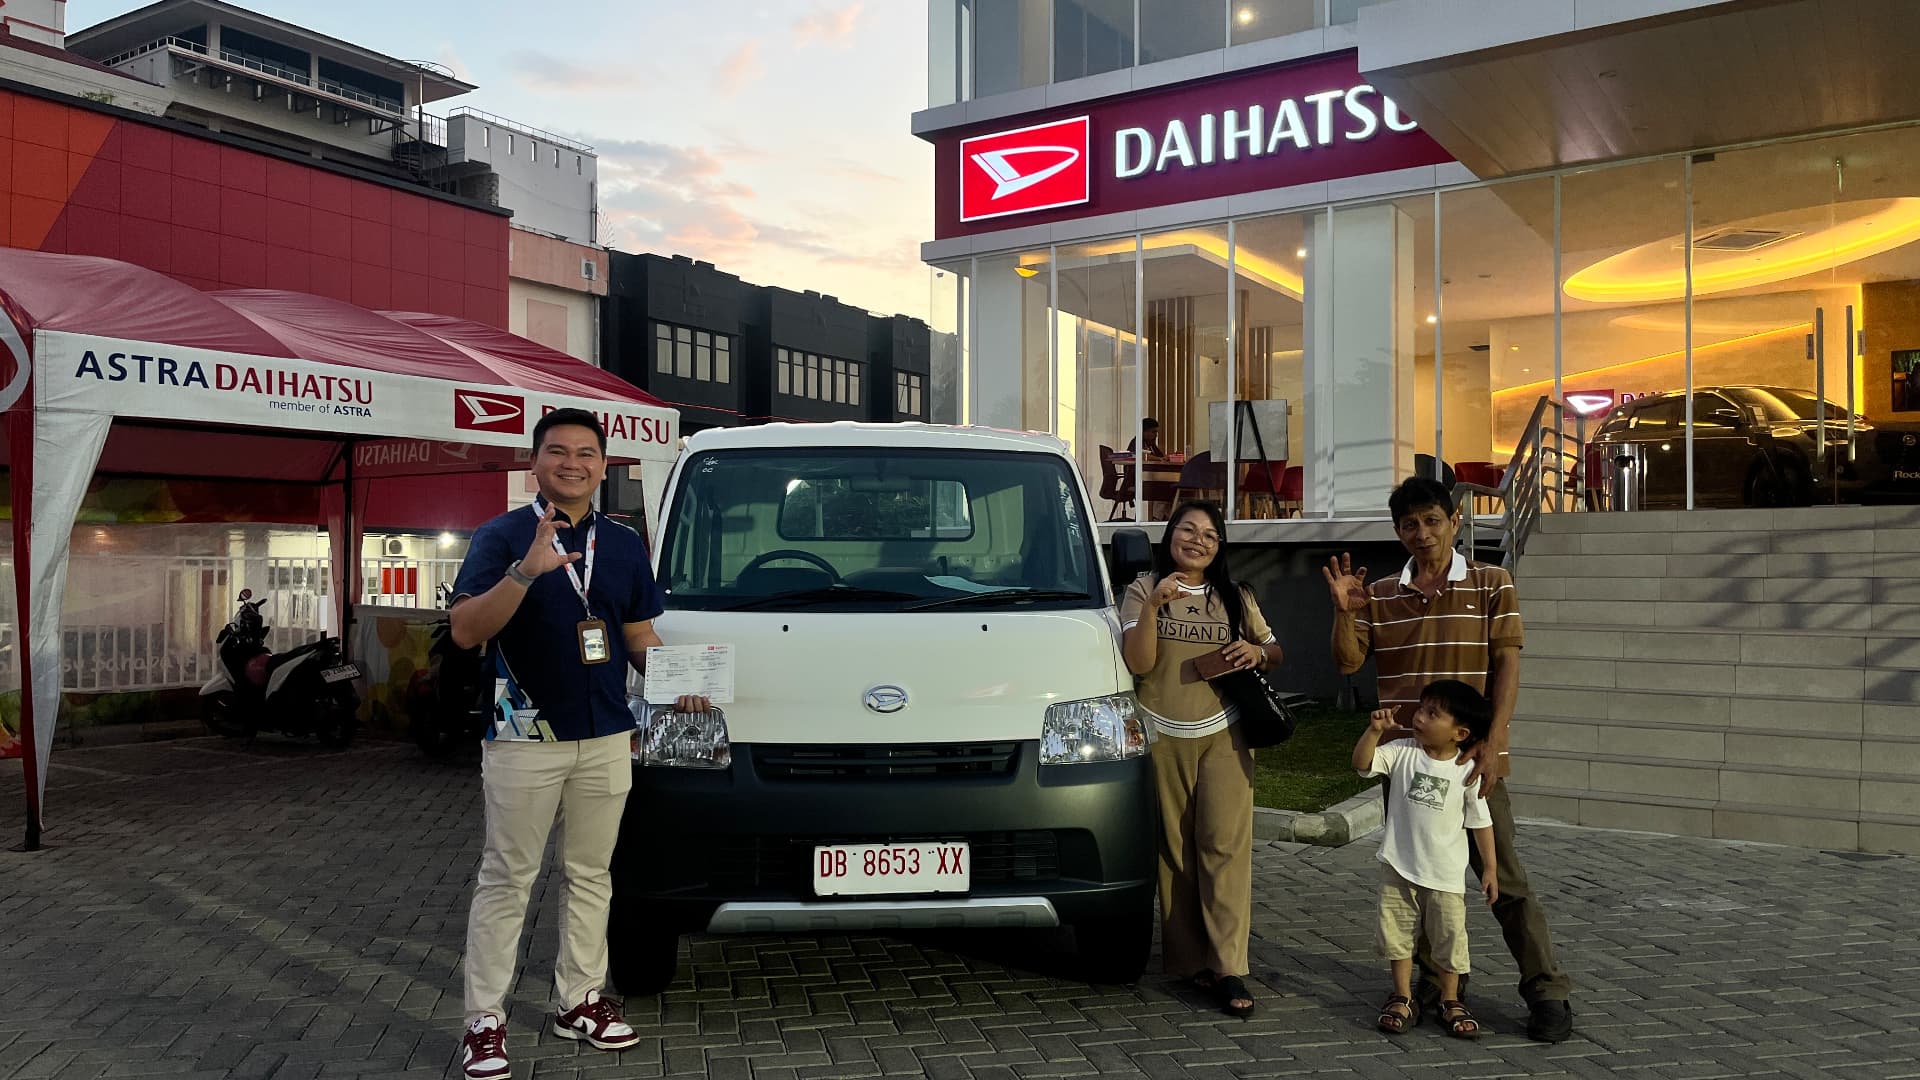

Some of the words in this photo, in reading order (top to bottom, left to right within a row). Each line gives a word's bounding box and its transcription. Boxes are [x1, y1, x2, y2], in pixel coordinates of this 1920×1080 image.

[75, 350, 209, 389] ASTRA
[215, 363, 373, 405] DAIHATSU
[269, 400, 315, 413] member
[319, 403, 330, 414] of
[333, 405, 372, 418] ASTRA
[542, 404, 670, 445] HATSU
[1157, 620, 1212, 641] RISTIAN
[820, 850, 847, 878] DB
[863, 848, 920, 876] 8653
[936, 847, 964, 875] XX
